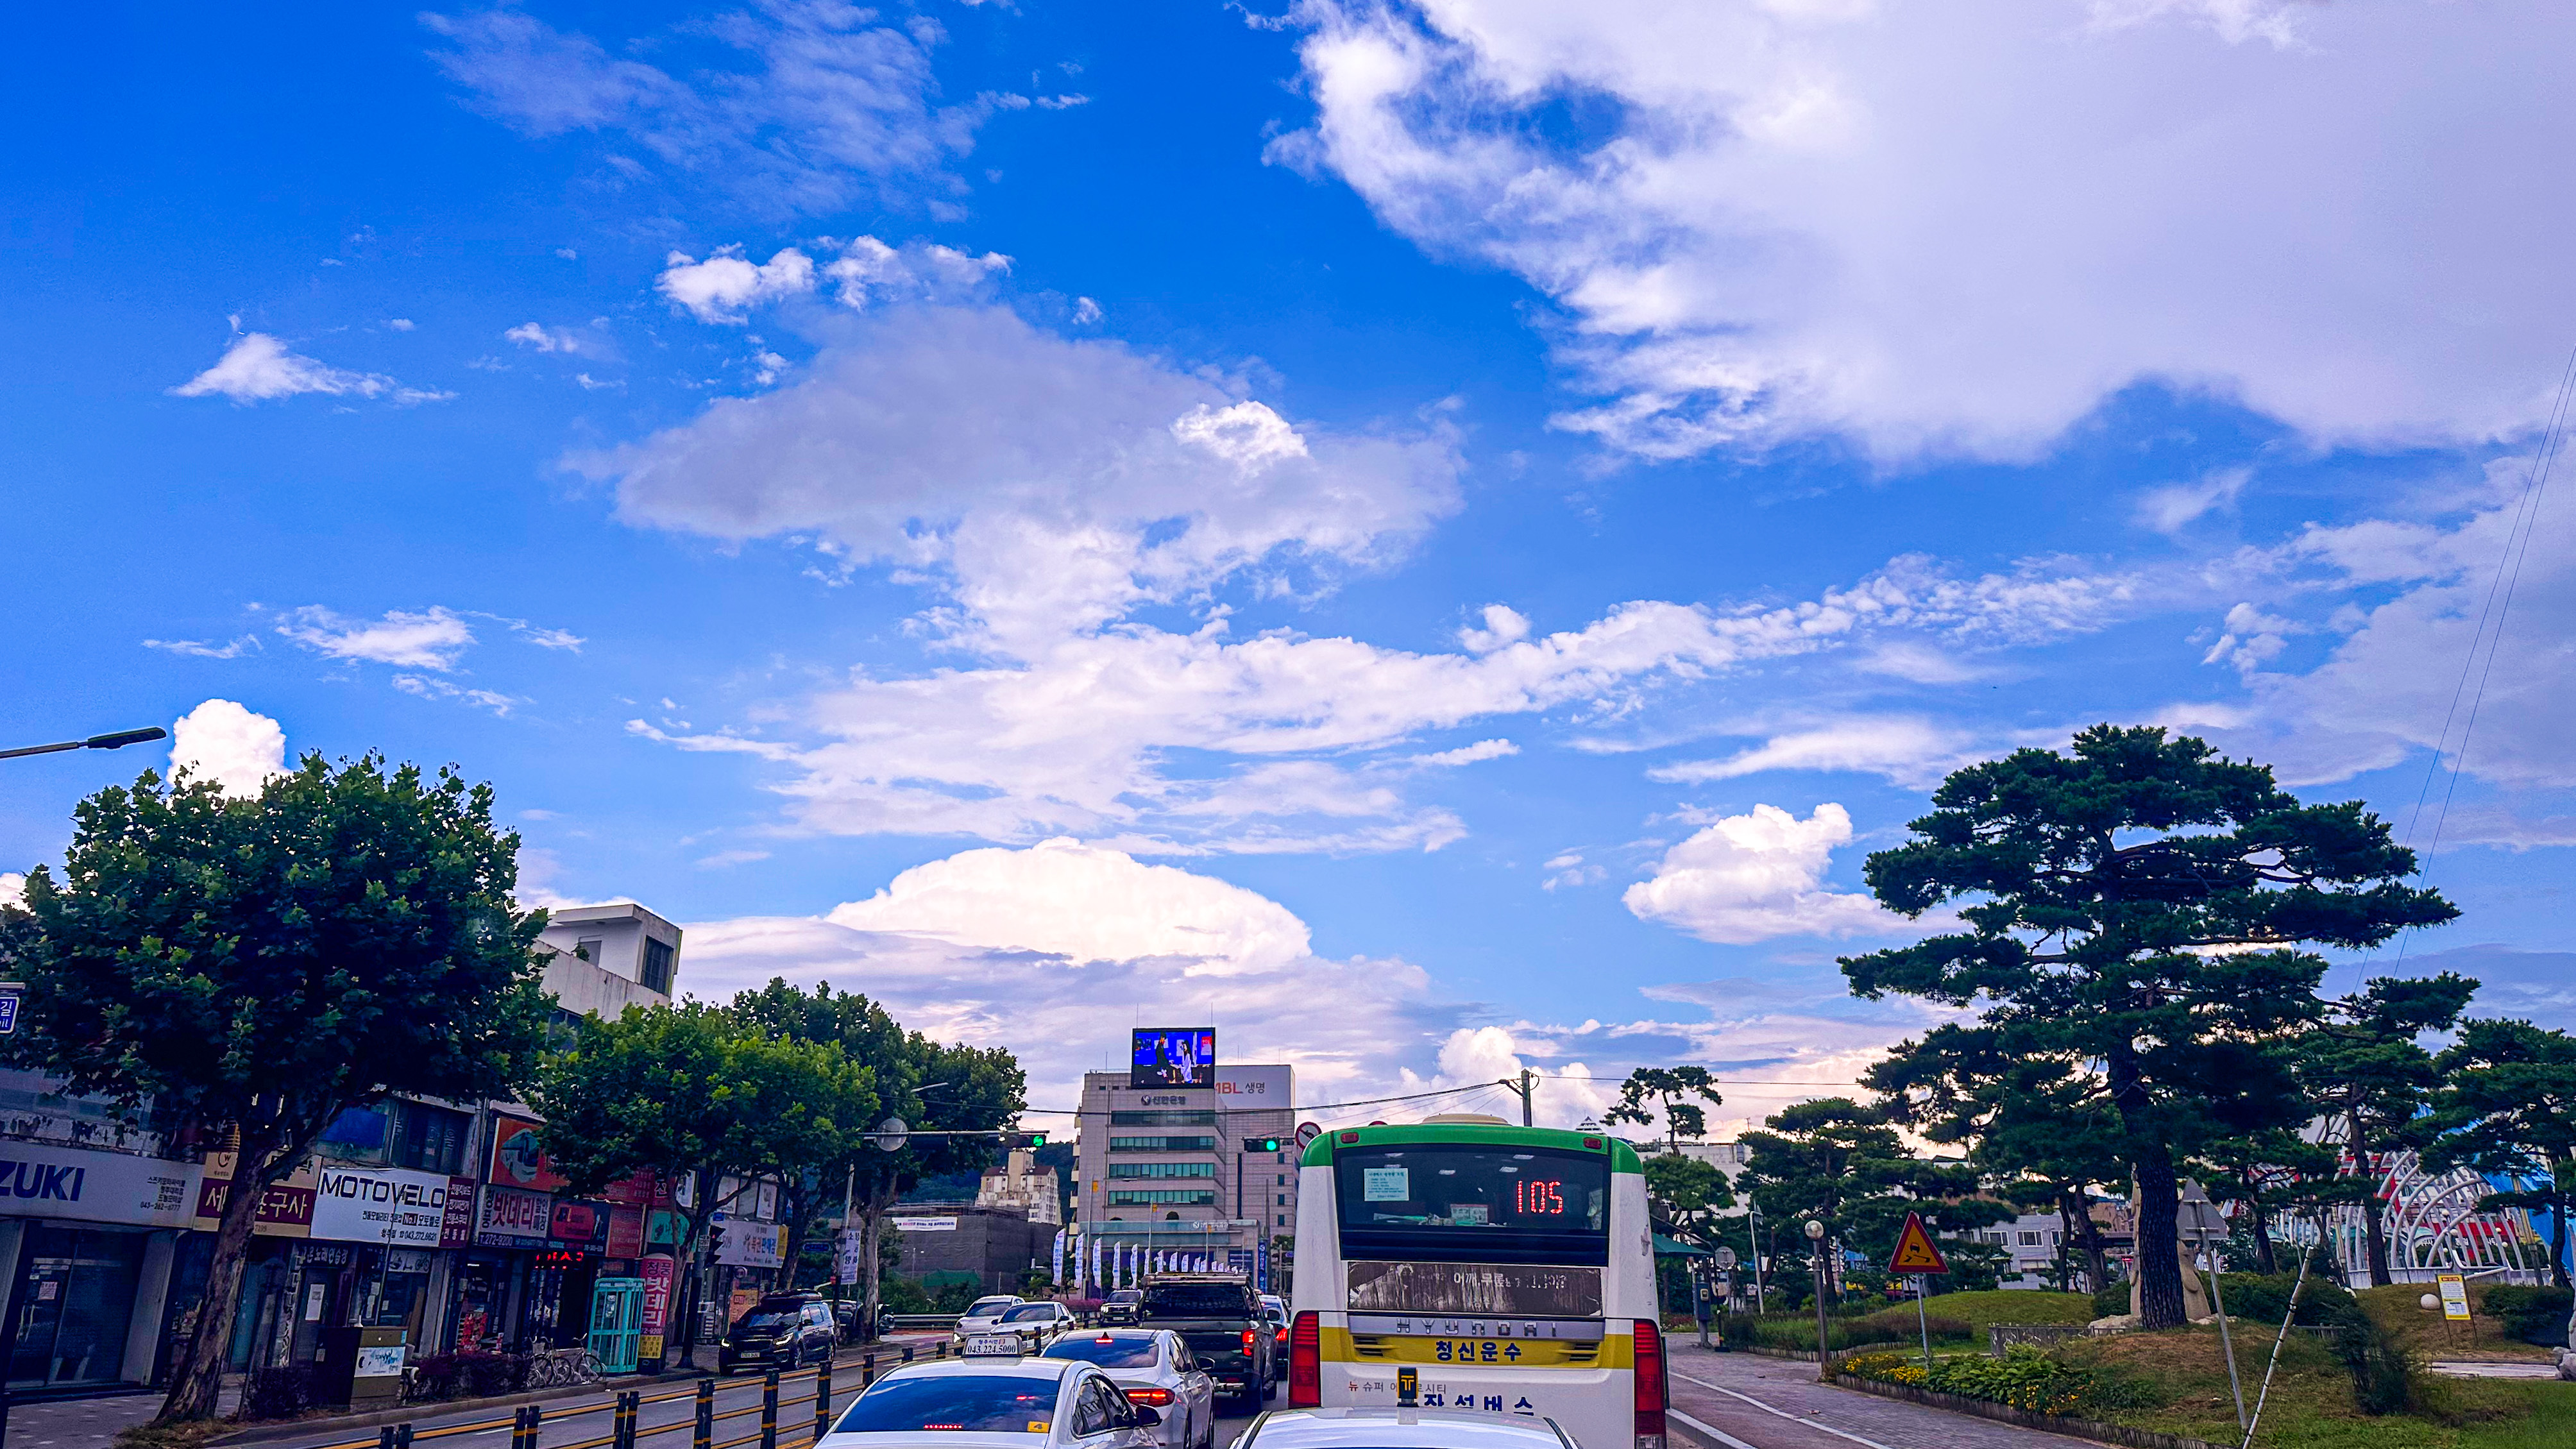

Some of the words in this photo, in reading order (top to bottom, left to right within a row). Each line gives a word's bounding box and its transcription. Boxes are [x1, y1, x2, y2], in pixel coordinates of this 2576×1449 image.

[1, 1001, 13, 1017] 길
[0, 1019, 8, 1028] il
[1245, 1082, 1265, 1094] 생명
[320, 1173, 446, 1208] MOTOVELO
[1518, 1180, 1563, 1214] 105
[492, 1191, 536, 1230] 밧데리
[647, 1261, 671, 1276] 청풍
[643, 1276, 669, 1326] 밧데리
[1396, 1318, 1557, 1337] HYUNDAI
[968, 1344, 1016, 1353] 043.224.5000
[1436, 1340, 1521, 1362] 청신운수
[1349, 1381, 1359, 1393] 뉴
[1362, 1382, 1384, 1393] 슈퍼
